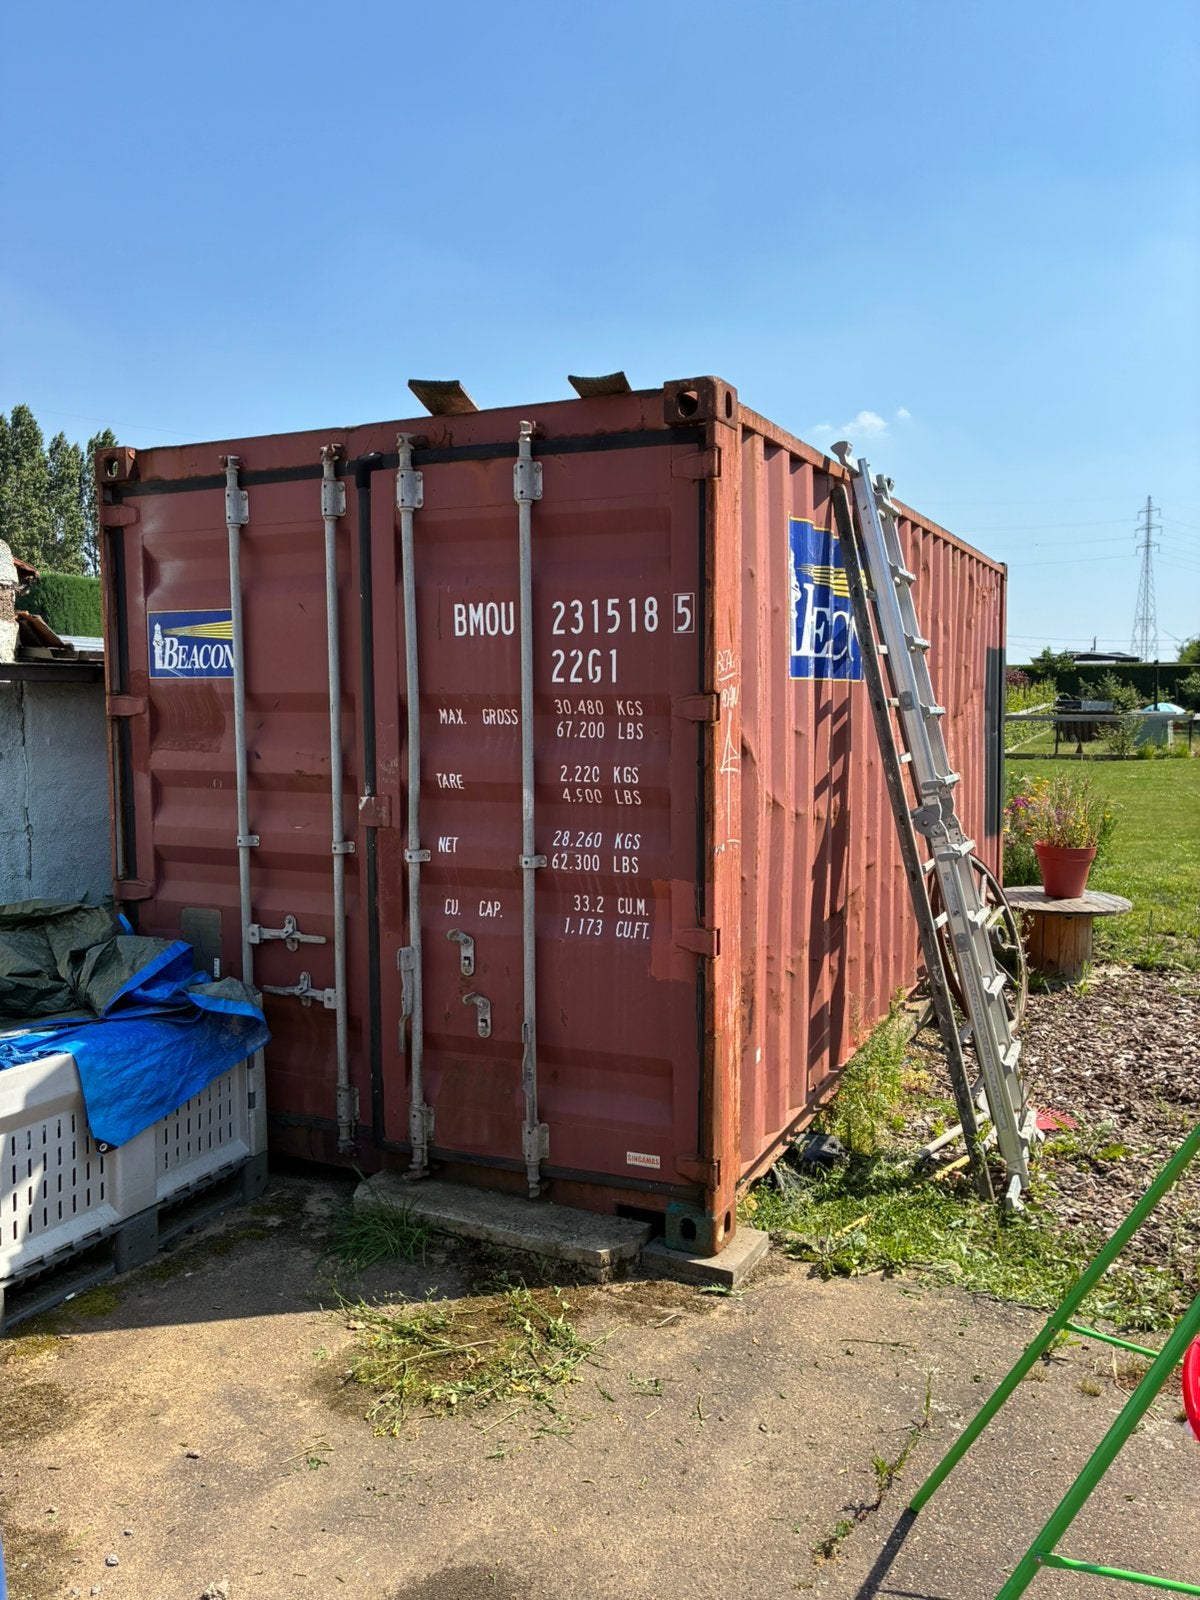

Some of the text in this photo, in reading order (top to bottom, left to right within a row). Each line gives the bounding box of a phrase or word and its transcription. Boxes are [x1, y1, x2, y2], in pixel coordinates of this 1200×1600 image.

[453, 594, 692, 637] BMOU 231518 5
[551, 648, 617, 684] 22G1
[438, 708, 519, 725] MAX. GROSS
[616, 699, 644, 716] KGS
[617, 722, 644, 740] LBS
[435, 773, 465, 790] TARE
[613, 766, 639, 784] KGS
[614, 789, 642, 805] LBS
[438, 836, 459, 853] NET
[614, 832, 641, 850] KGS
[613, 856, 639, 874] LBS
[444, 898, 503, 918] CU. CAP.
[573, 895, 649, 916] 33.2 CU.M.
[615, 920, 650, 940] CU.FT.
